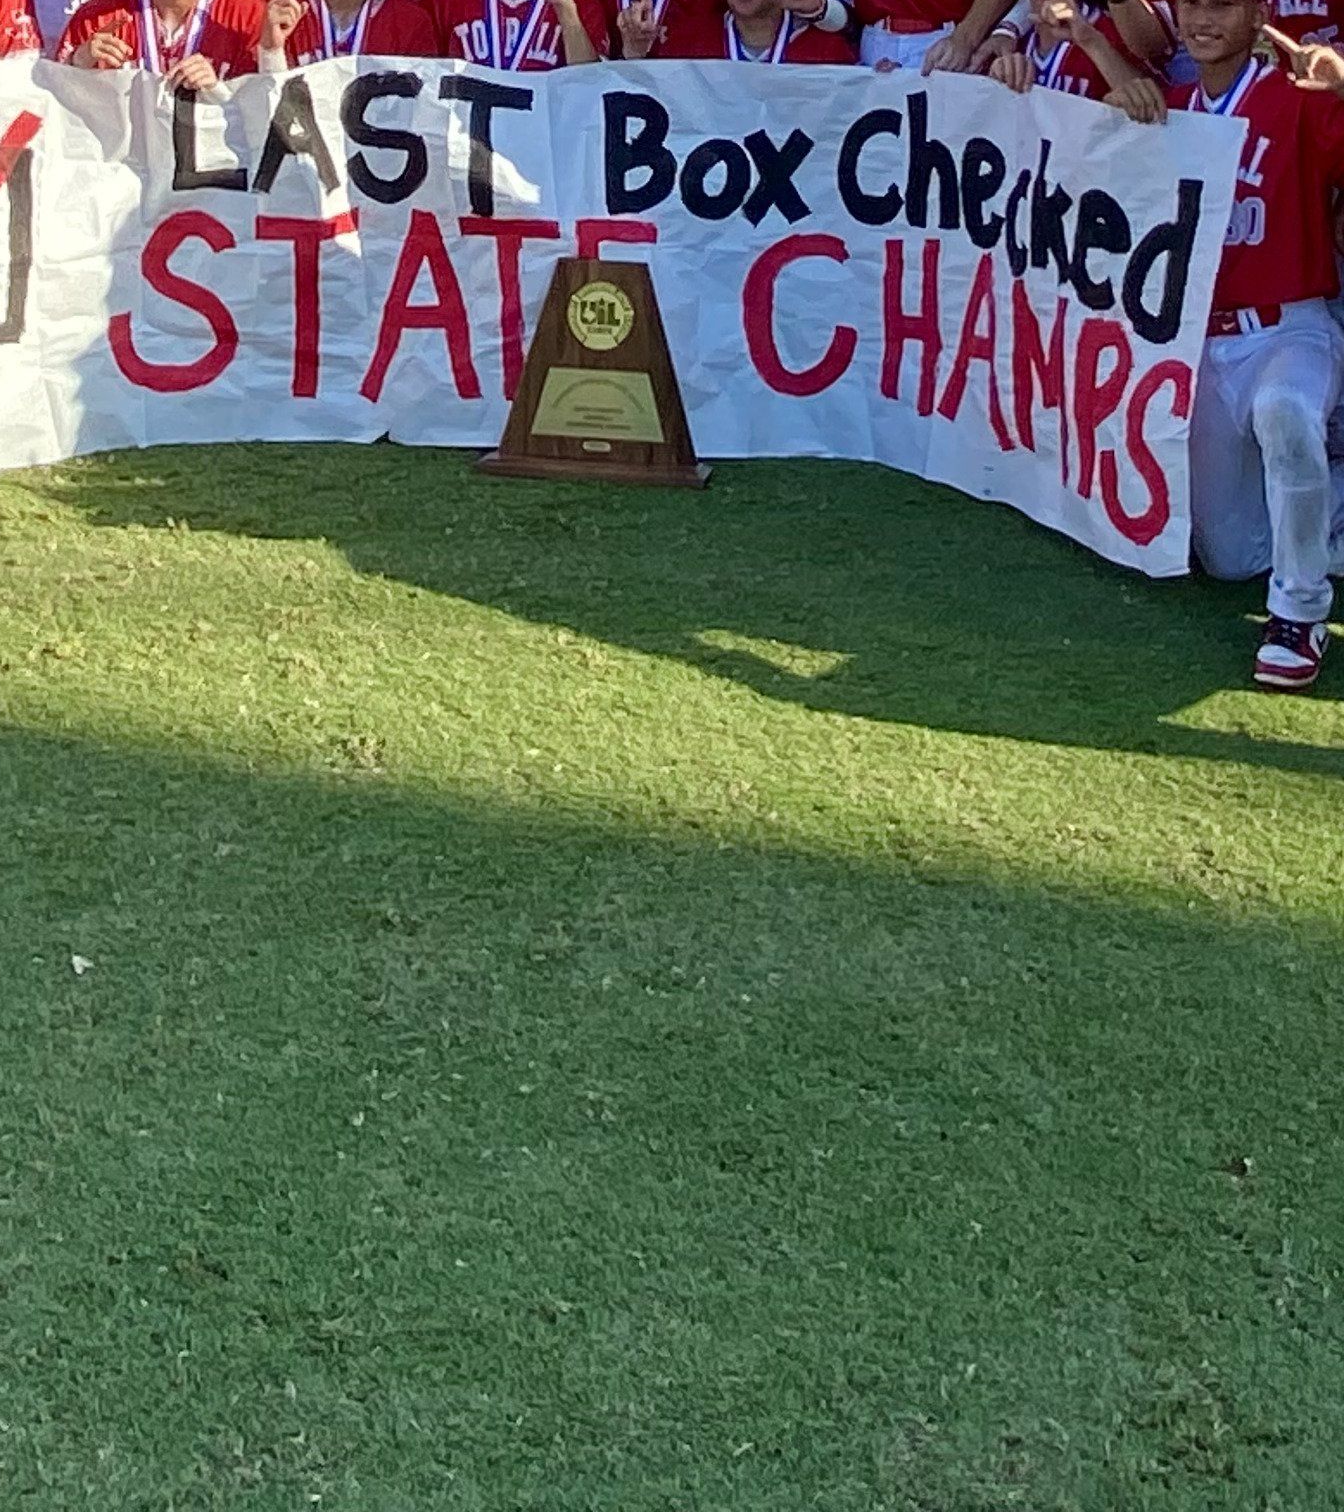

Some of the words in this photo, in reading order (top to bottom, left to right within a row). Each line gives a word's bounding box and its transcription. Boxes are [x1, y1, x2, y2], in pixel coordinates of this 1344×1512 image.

[172, 71, 534, 217] LAST
[602, 90, 816, 226] Box
[836, 90, 1205, 345] Checked
[107, 208, 658, 404] STAT
[740, 231, 1194, 548] CHAMPS
